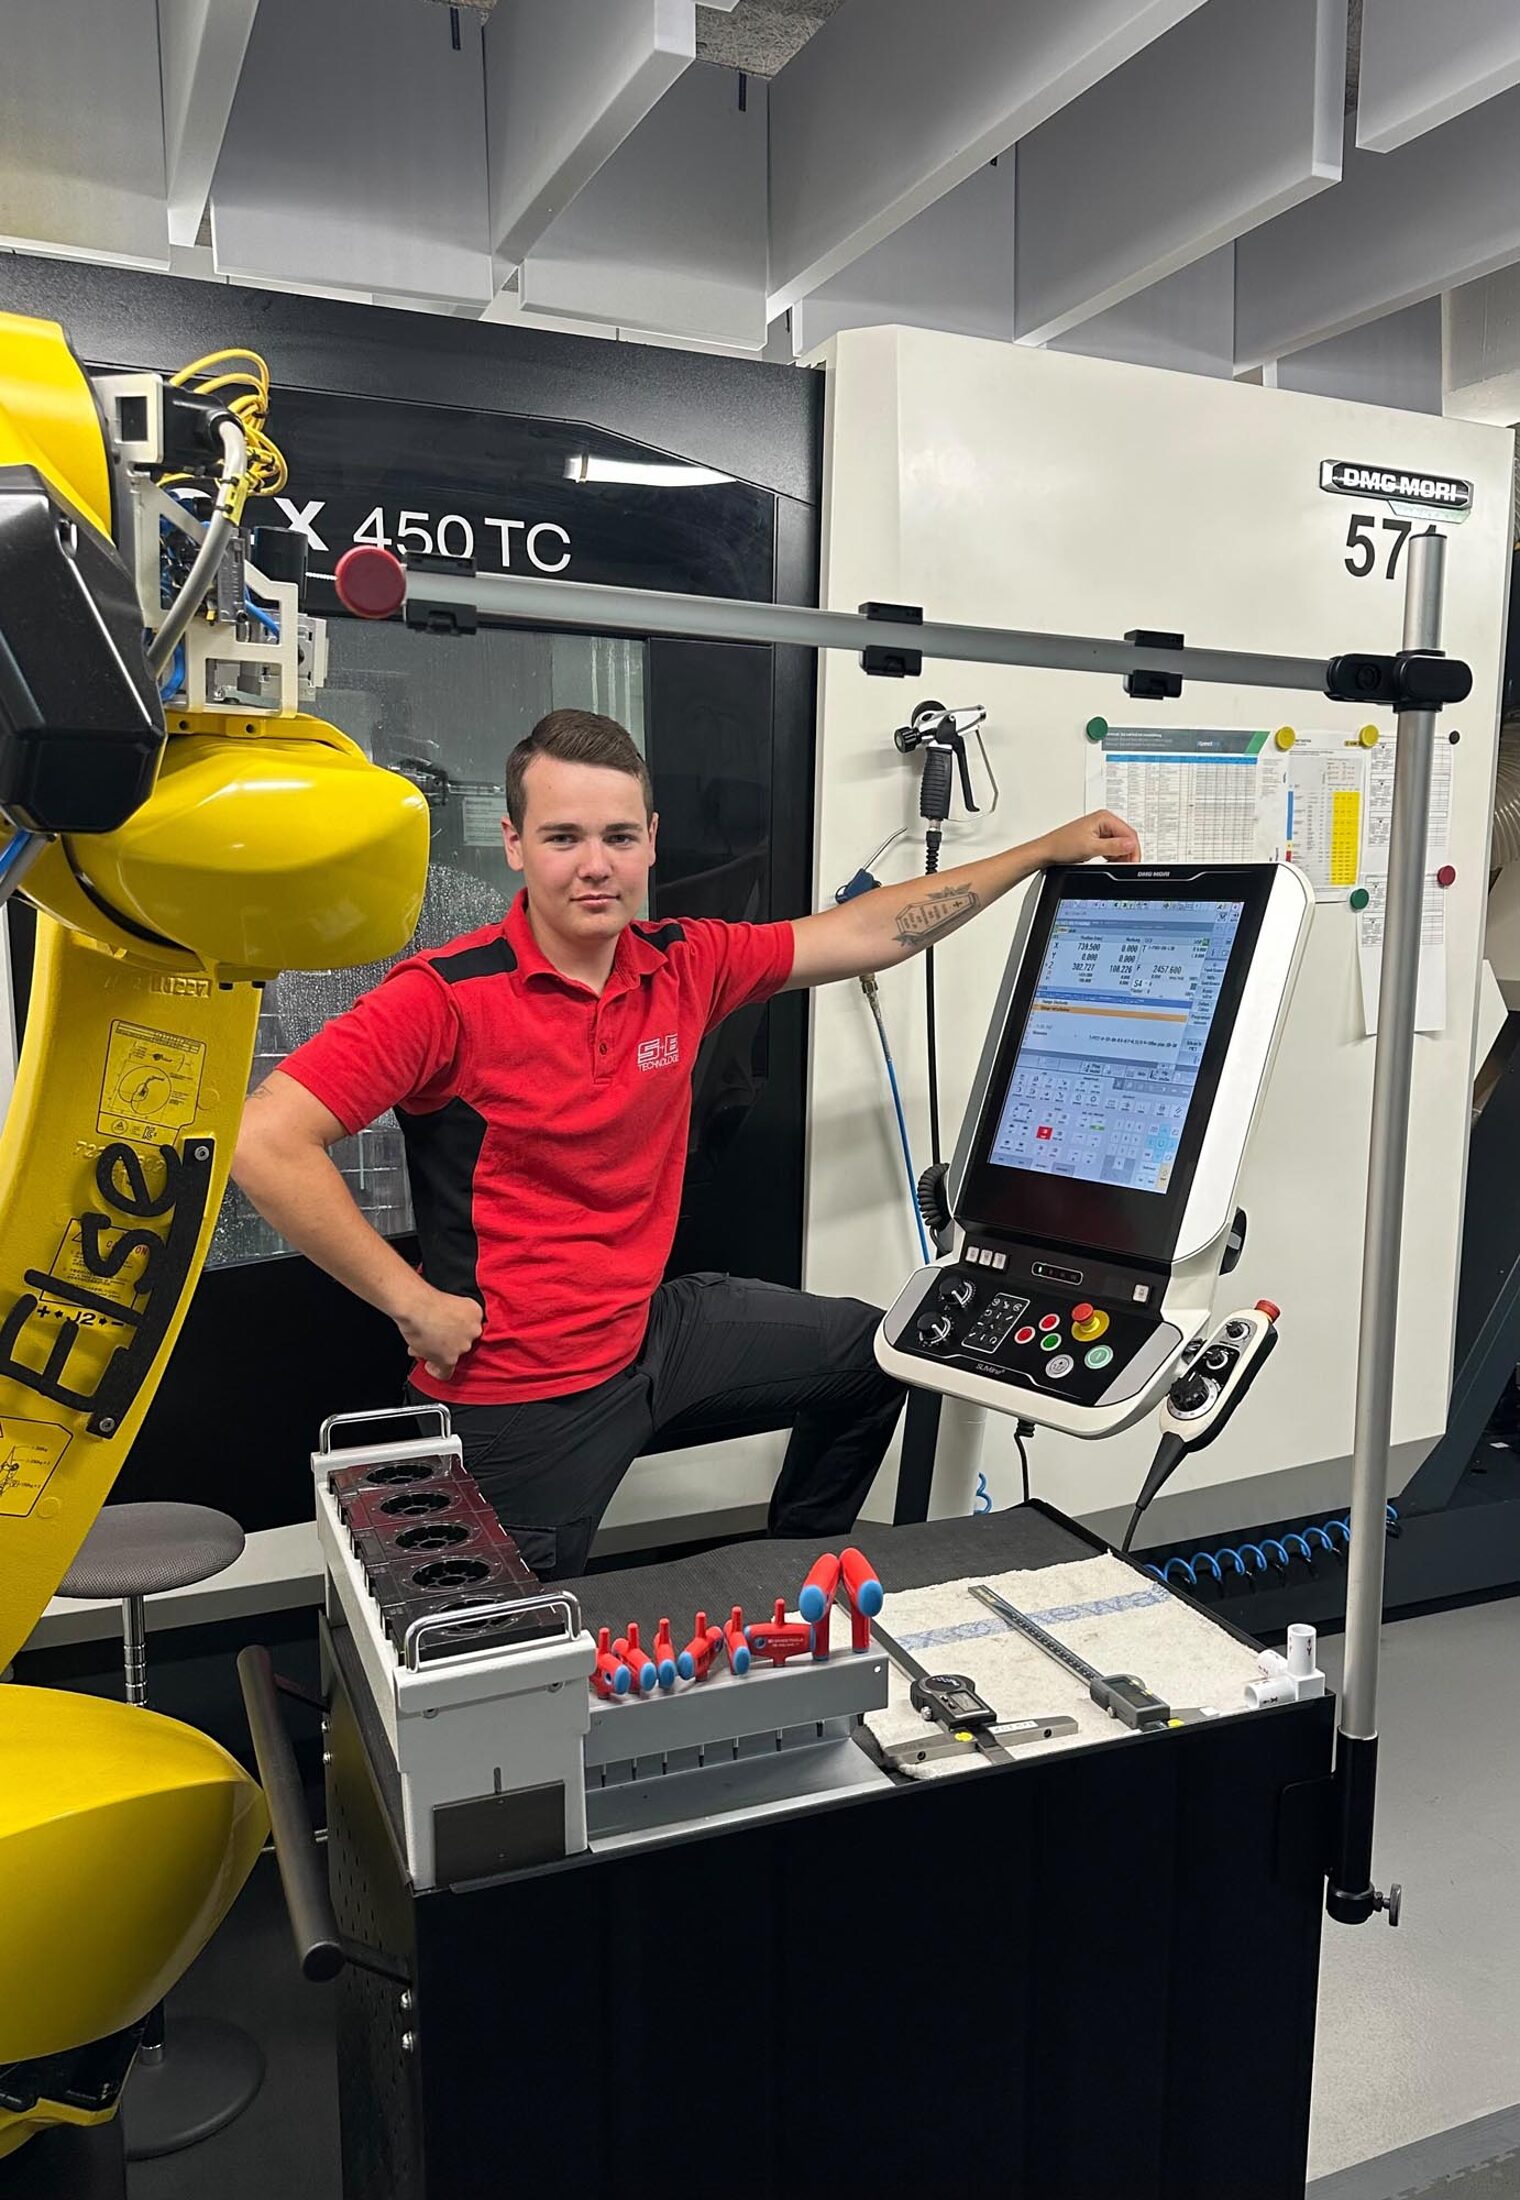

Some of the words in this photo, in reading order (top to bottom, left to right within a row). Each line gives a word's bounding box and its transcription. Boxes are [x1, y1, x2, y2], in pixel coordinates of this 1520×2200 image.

[1344, 468, 1396, 492] DMG
[1400, 477, 1456, 501] MORI
[352, 506, 475, 558] 450
[484, 516, 572, 573] TC
[0, 1141, 190, 1414] Else
